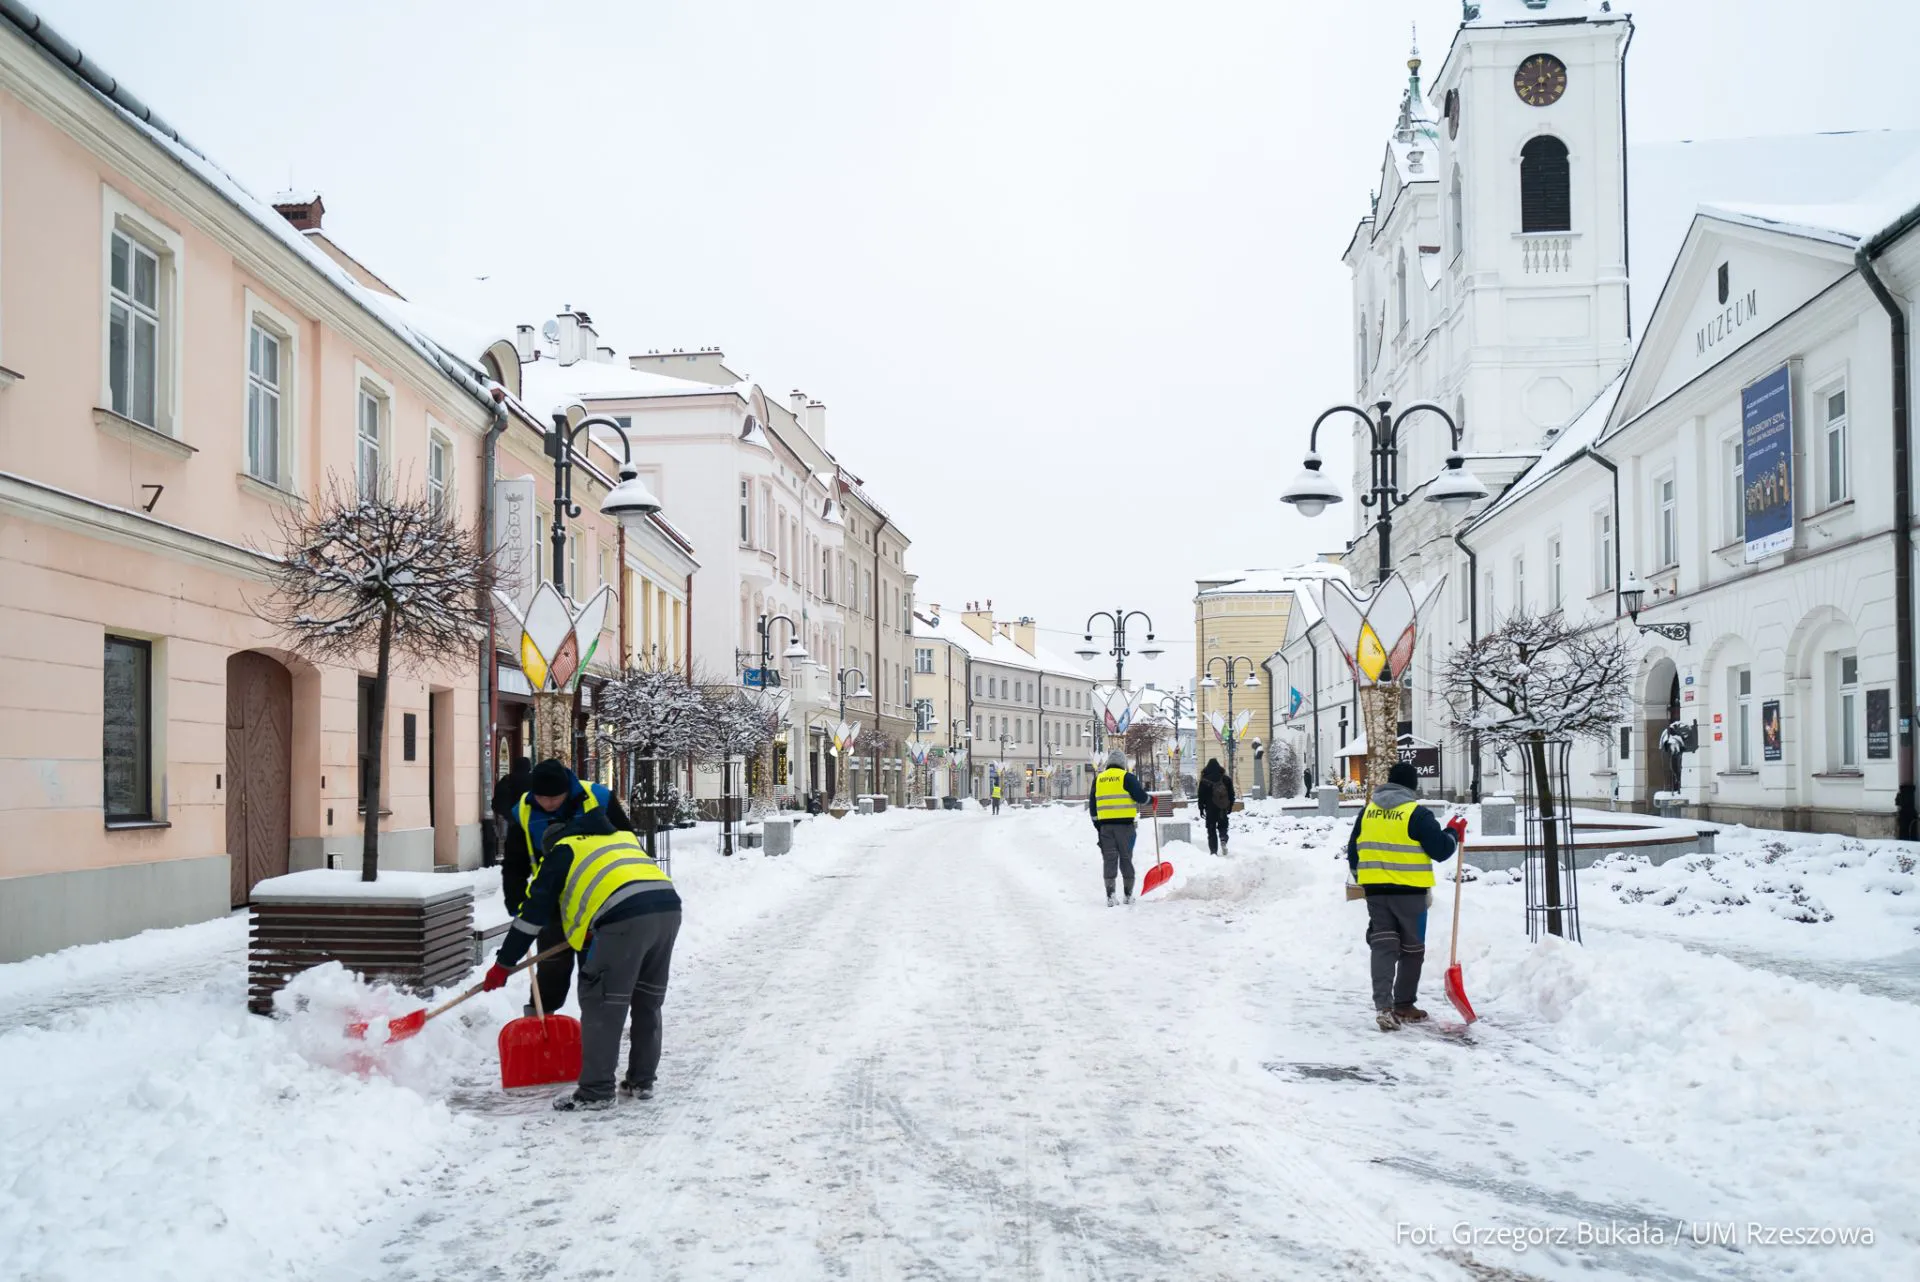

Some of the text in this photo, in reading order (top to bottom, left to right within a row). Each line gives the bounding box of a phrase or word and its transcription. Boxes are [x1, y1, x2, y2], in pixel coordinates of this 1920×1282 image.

[1697, 289, 1756, 358] MUZEUM
[1397, 750, 1417, 760] TAS
[1415, 765, 1435, 775] RAE
[1367, 809, 1404, 820] MPWiK
